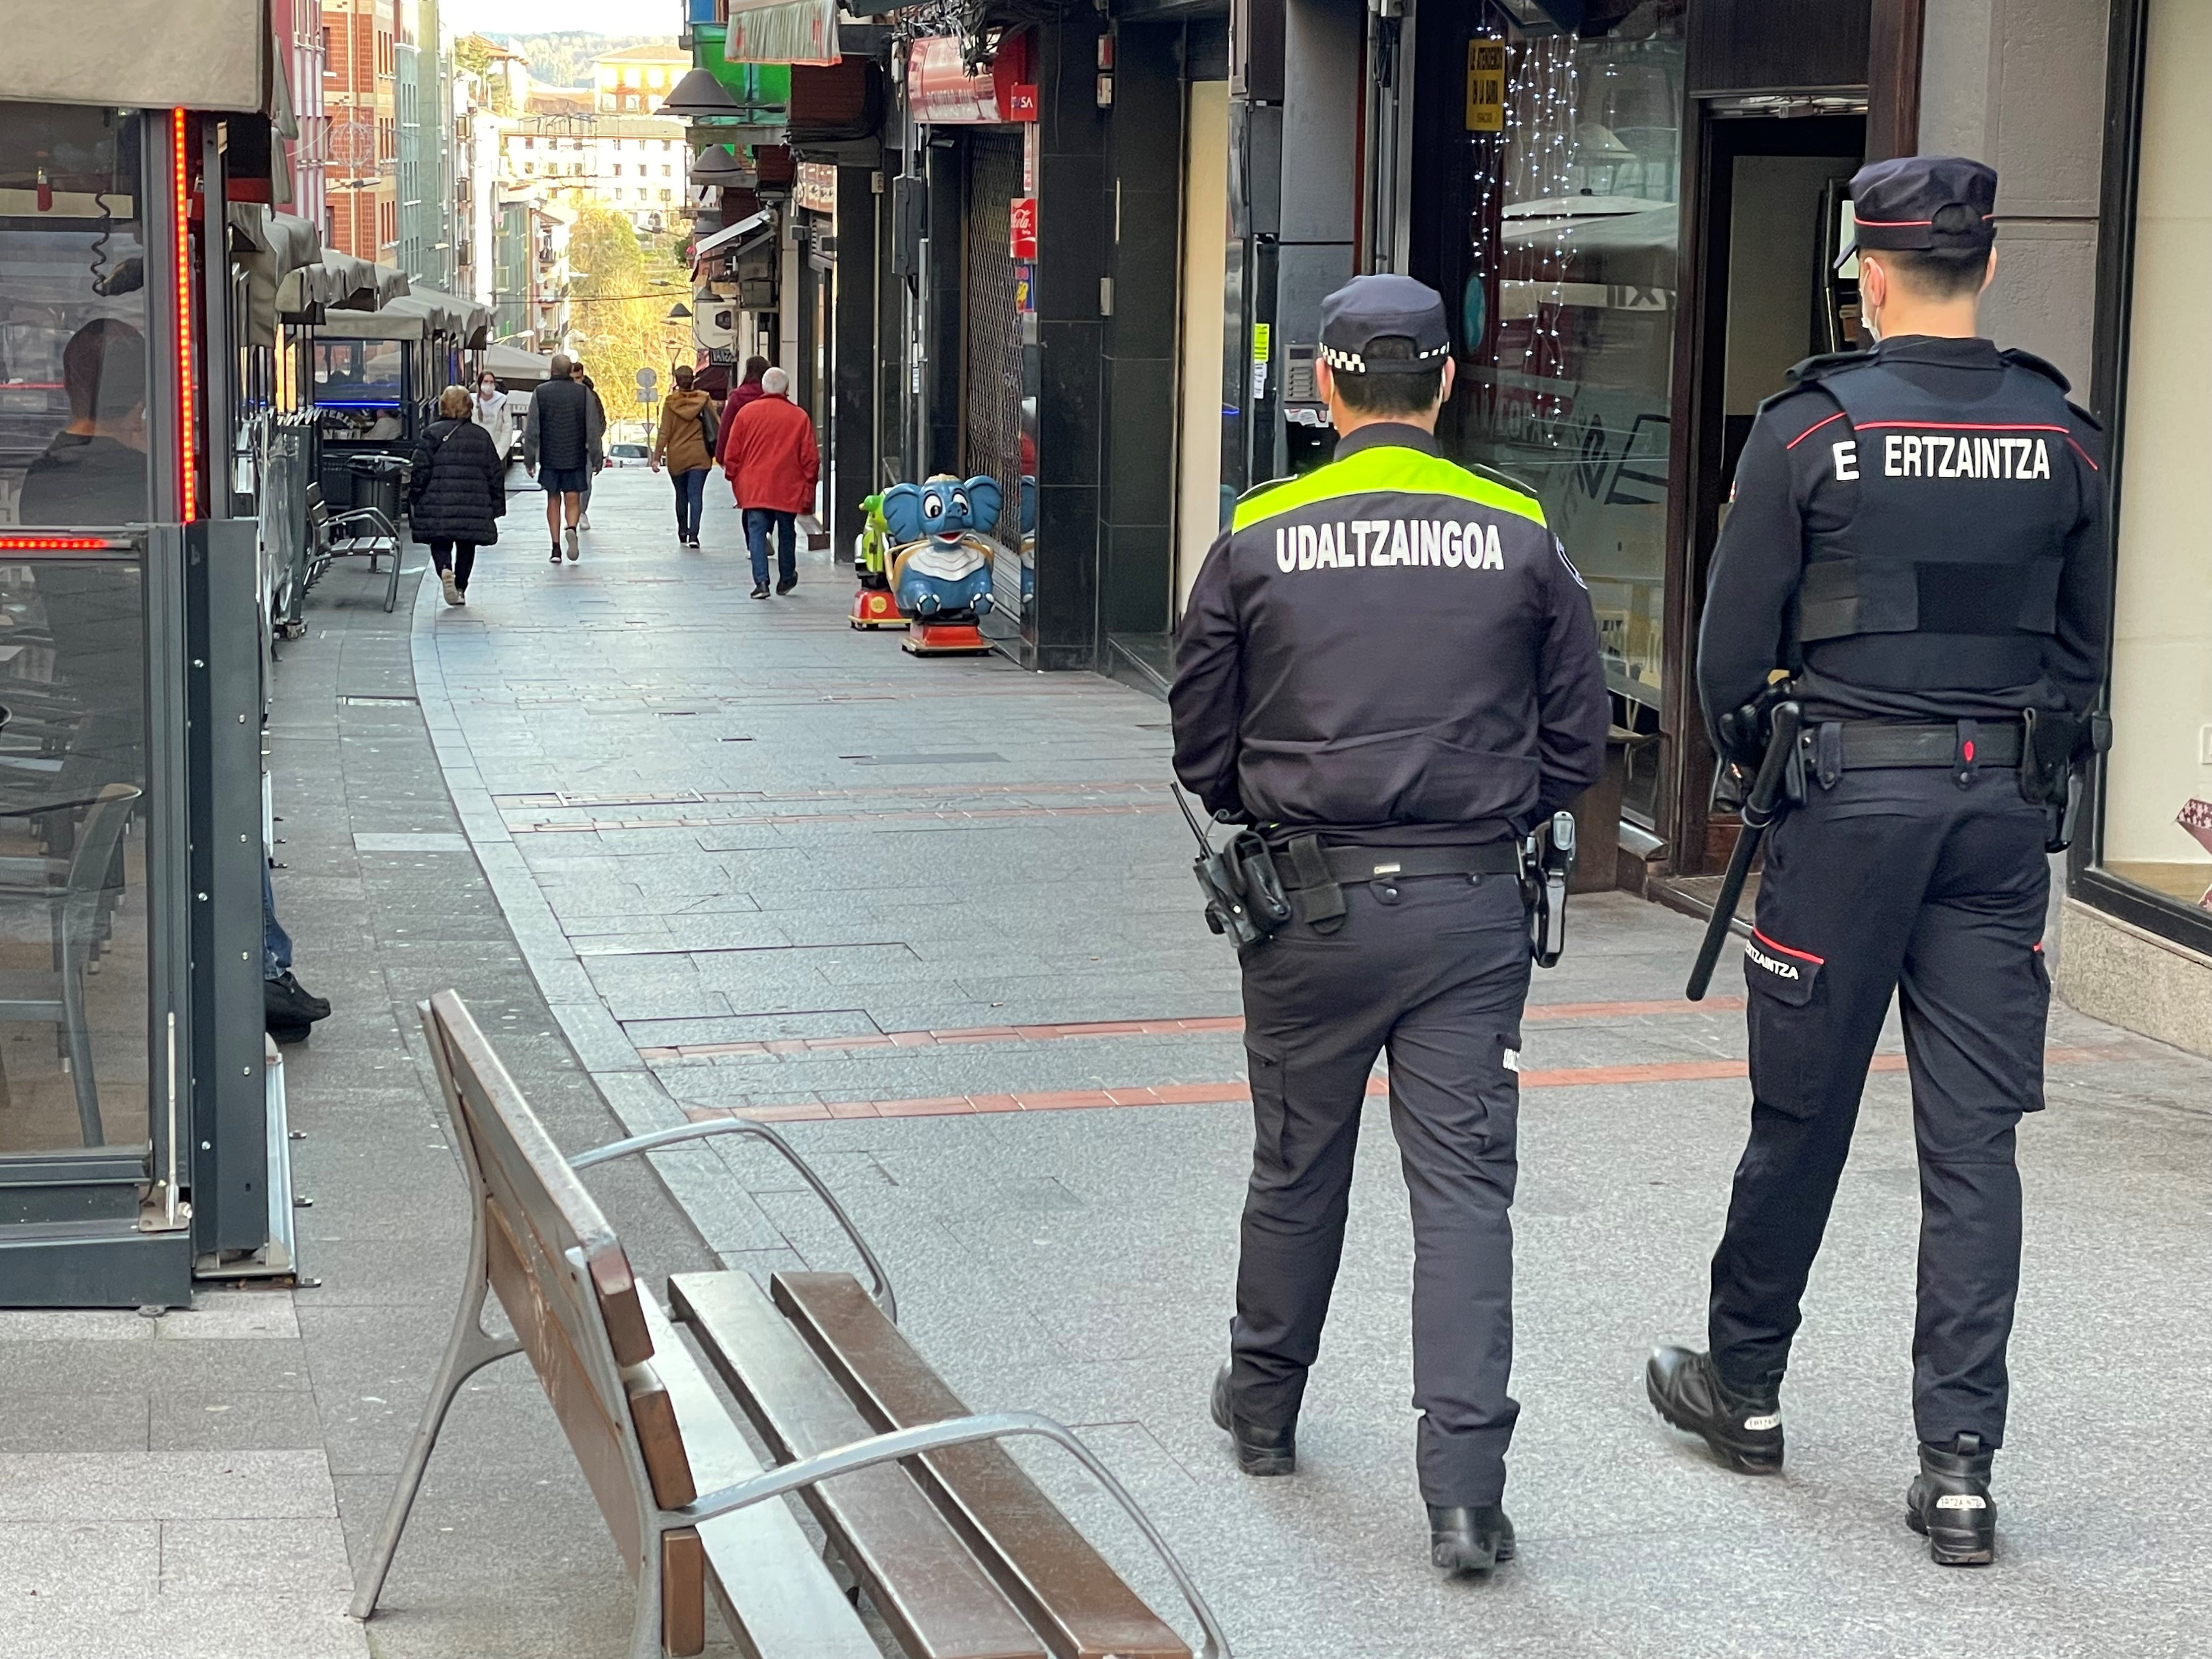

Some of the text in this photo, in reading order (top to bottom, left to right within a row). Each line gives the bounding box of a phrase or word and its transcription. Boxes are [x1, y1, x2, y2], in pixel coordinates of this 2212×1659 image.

[1832, 435, 2049, 481] E ERTZAINTZA
[1276, 520, 1504, 572] UDALTZAINGOA
